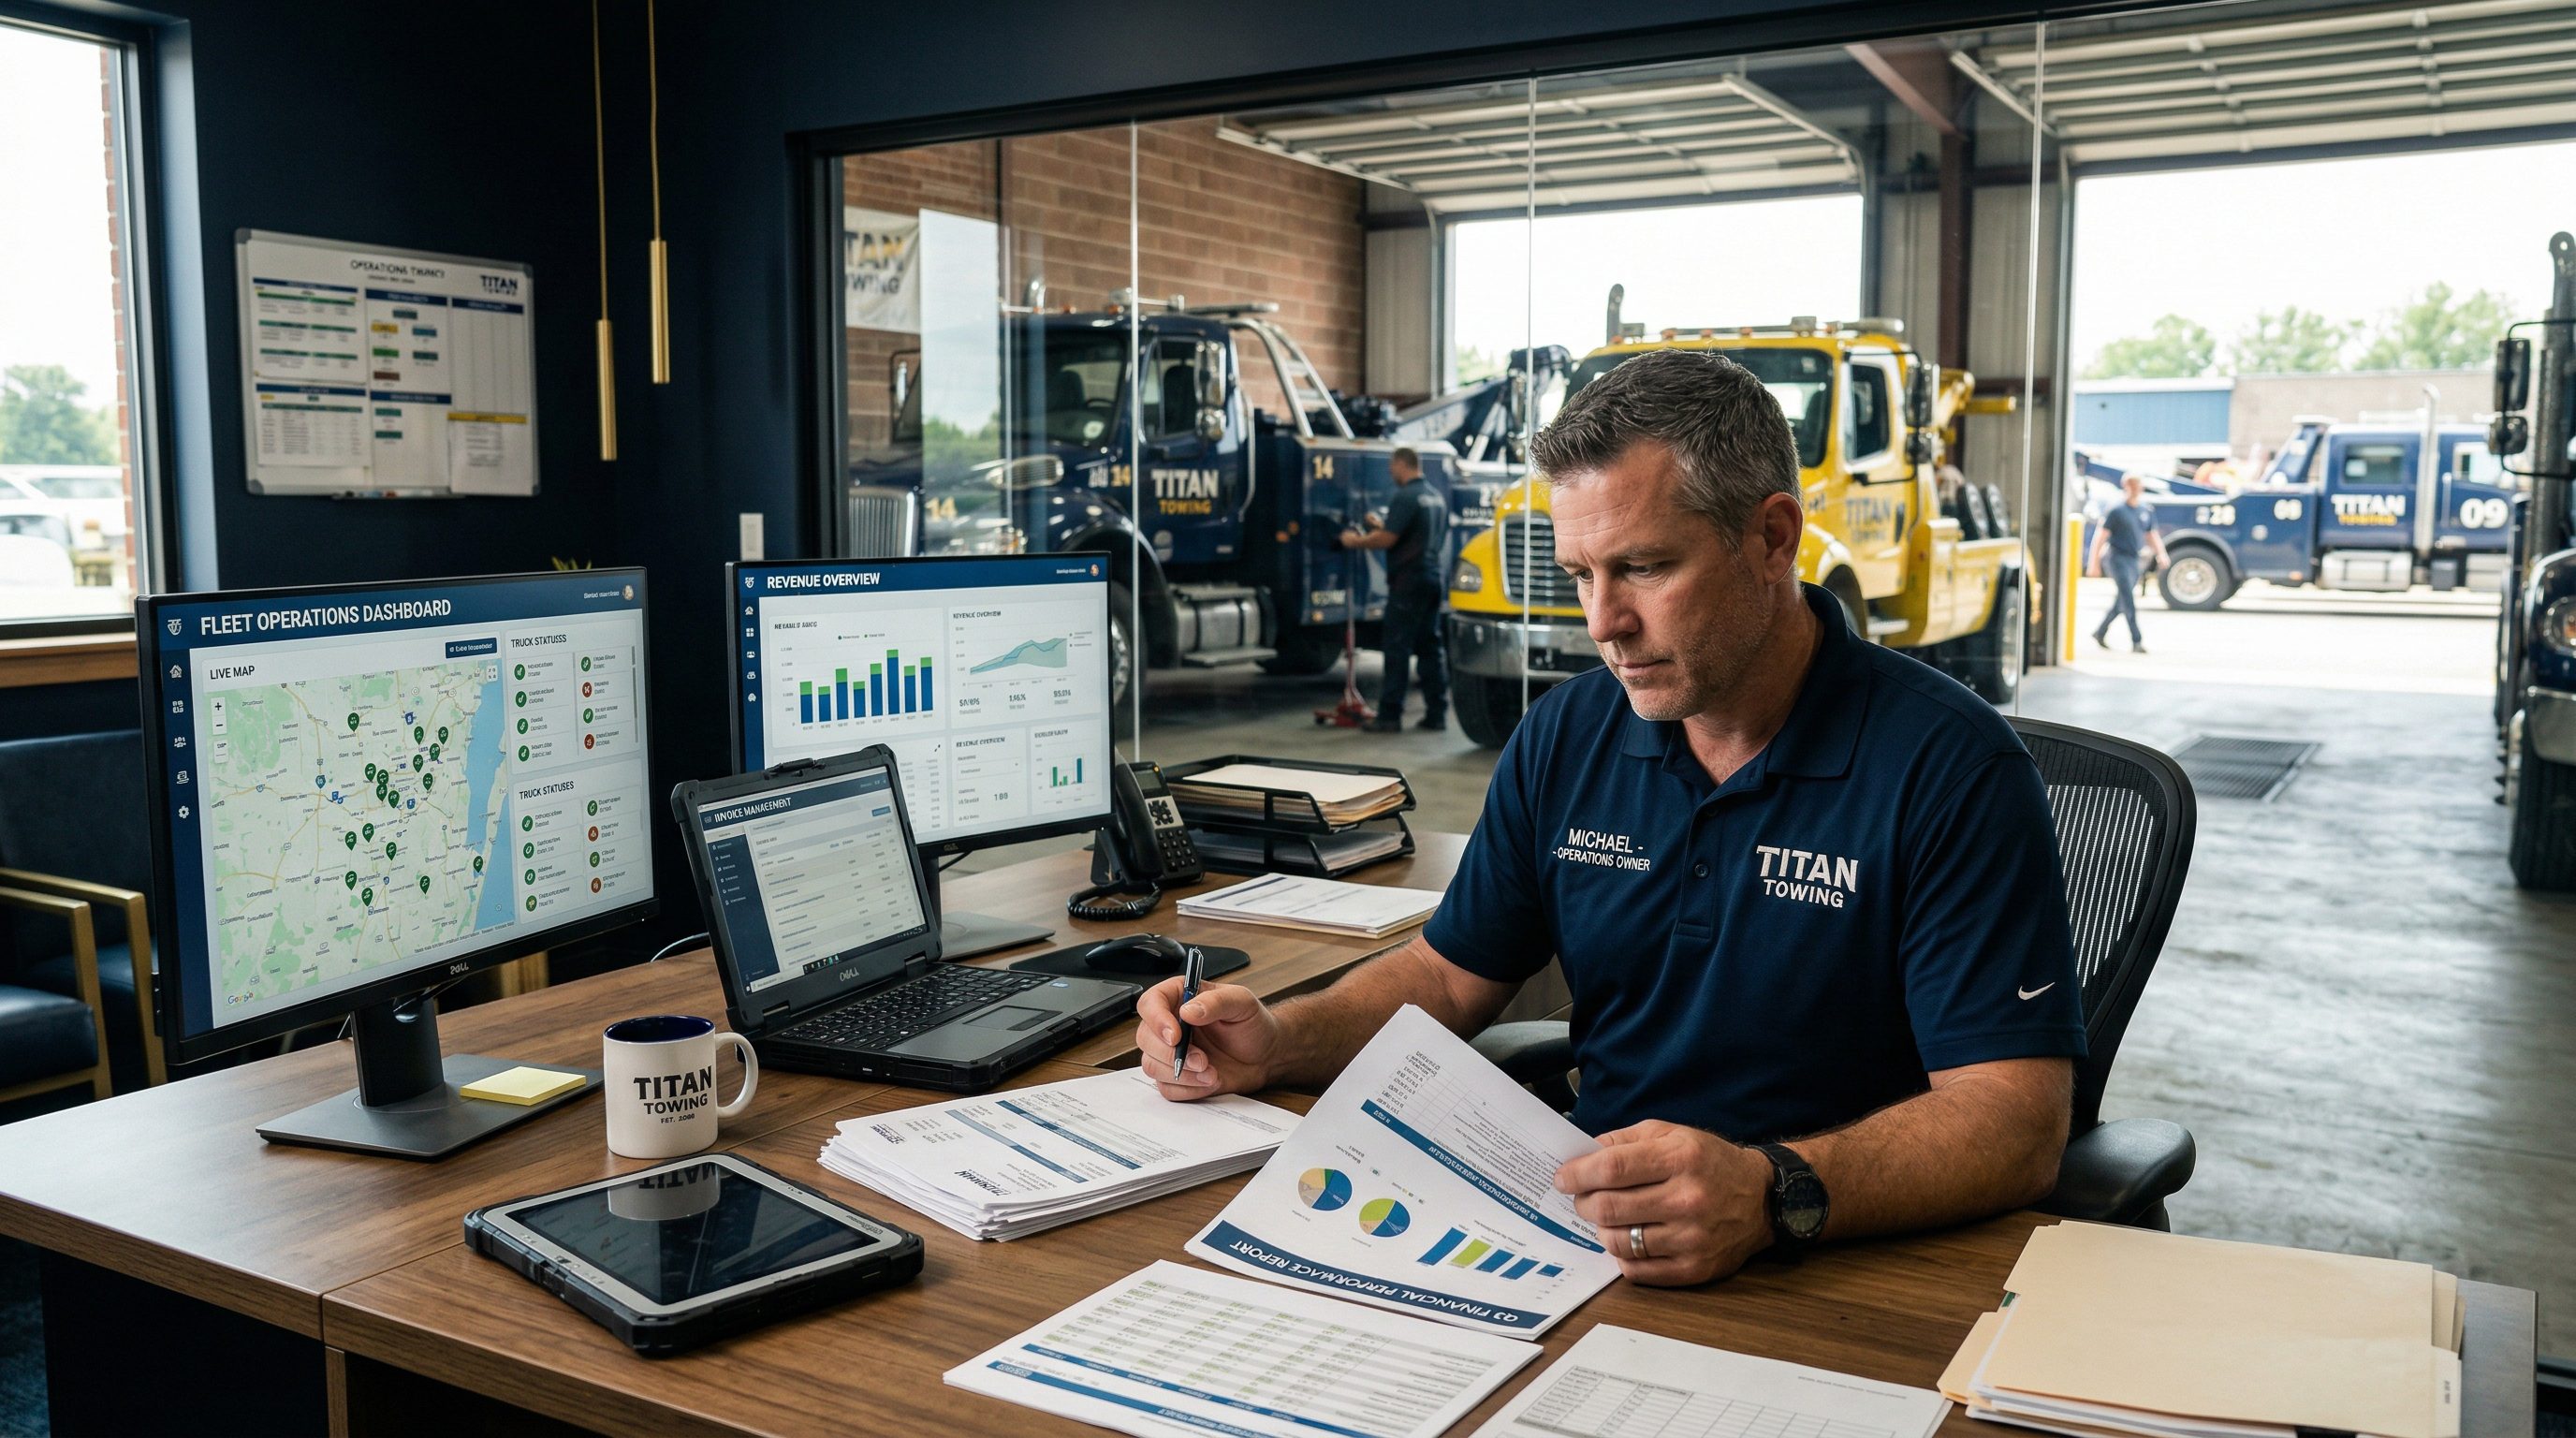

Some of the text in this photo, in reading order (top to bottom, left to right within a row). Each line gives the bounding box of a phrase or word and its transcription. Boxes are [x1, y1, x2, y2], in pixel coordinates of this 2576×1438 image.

[480, 274, 518, 290] TITAN
[1311, 455, 1334, 479] 14
[1150, 469, 1220, 499] TITAN
[1160, 499, 1212, 514] TOWING
[2331, 493, 2407, 516] TITAN
[2460, 497, 2509, 530] 09
[767, 572, 881, 589] REVENUE OVERVIEW
[200, 598, 451, 636] FLEET OPERATIONS DASHBOARD
[510, 638, 534, 648] TRUCK
[210, 665, 256, 681] LIVE MAP
[519, 787, 542, 800] TRUCK
[1567, 828, 1633, 854] MICHAEL
[1616, 855, 1650, 872] OWNER
[1756, 844, 1859, 893] TITAN
[1764, 878, 1844, 908] TOWING
[633, 1065, 712, 1100] TITAN
[643, 1093, 709, 1115] TOWING
[1229, 1240, 1290, 1269] REPORT
[1401, 1288, 1492, 1317] FINANCIAL
